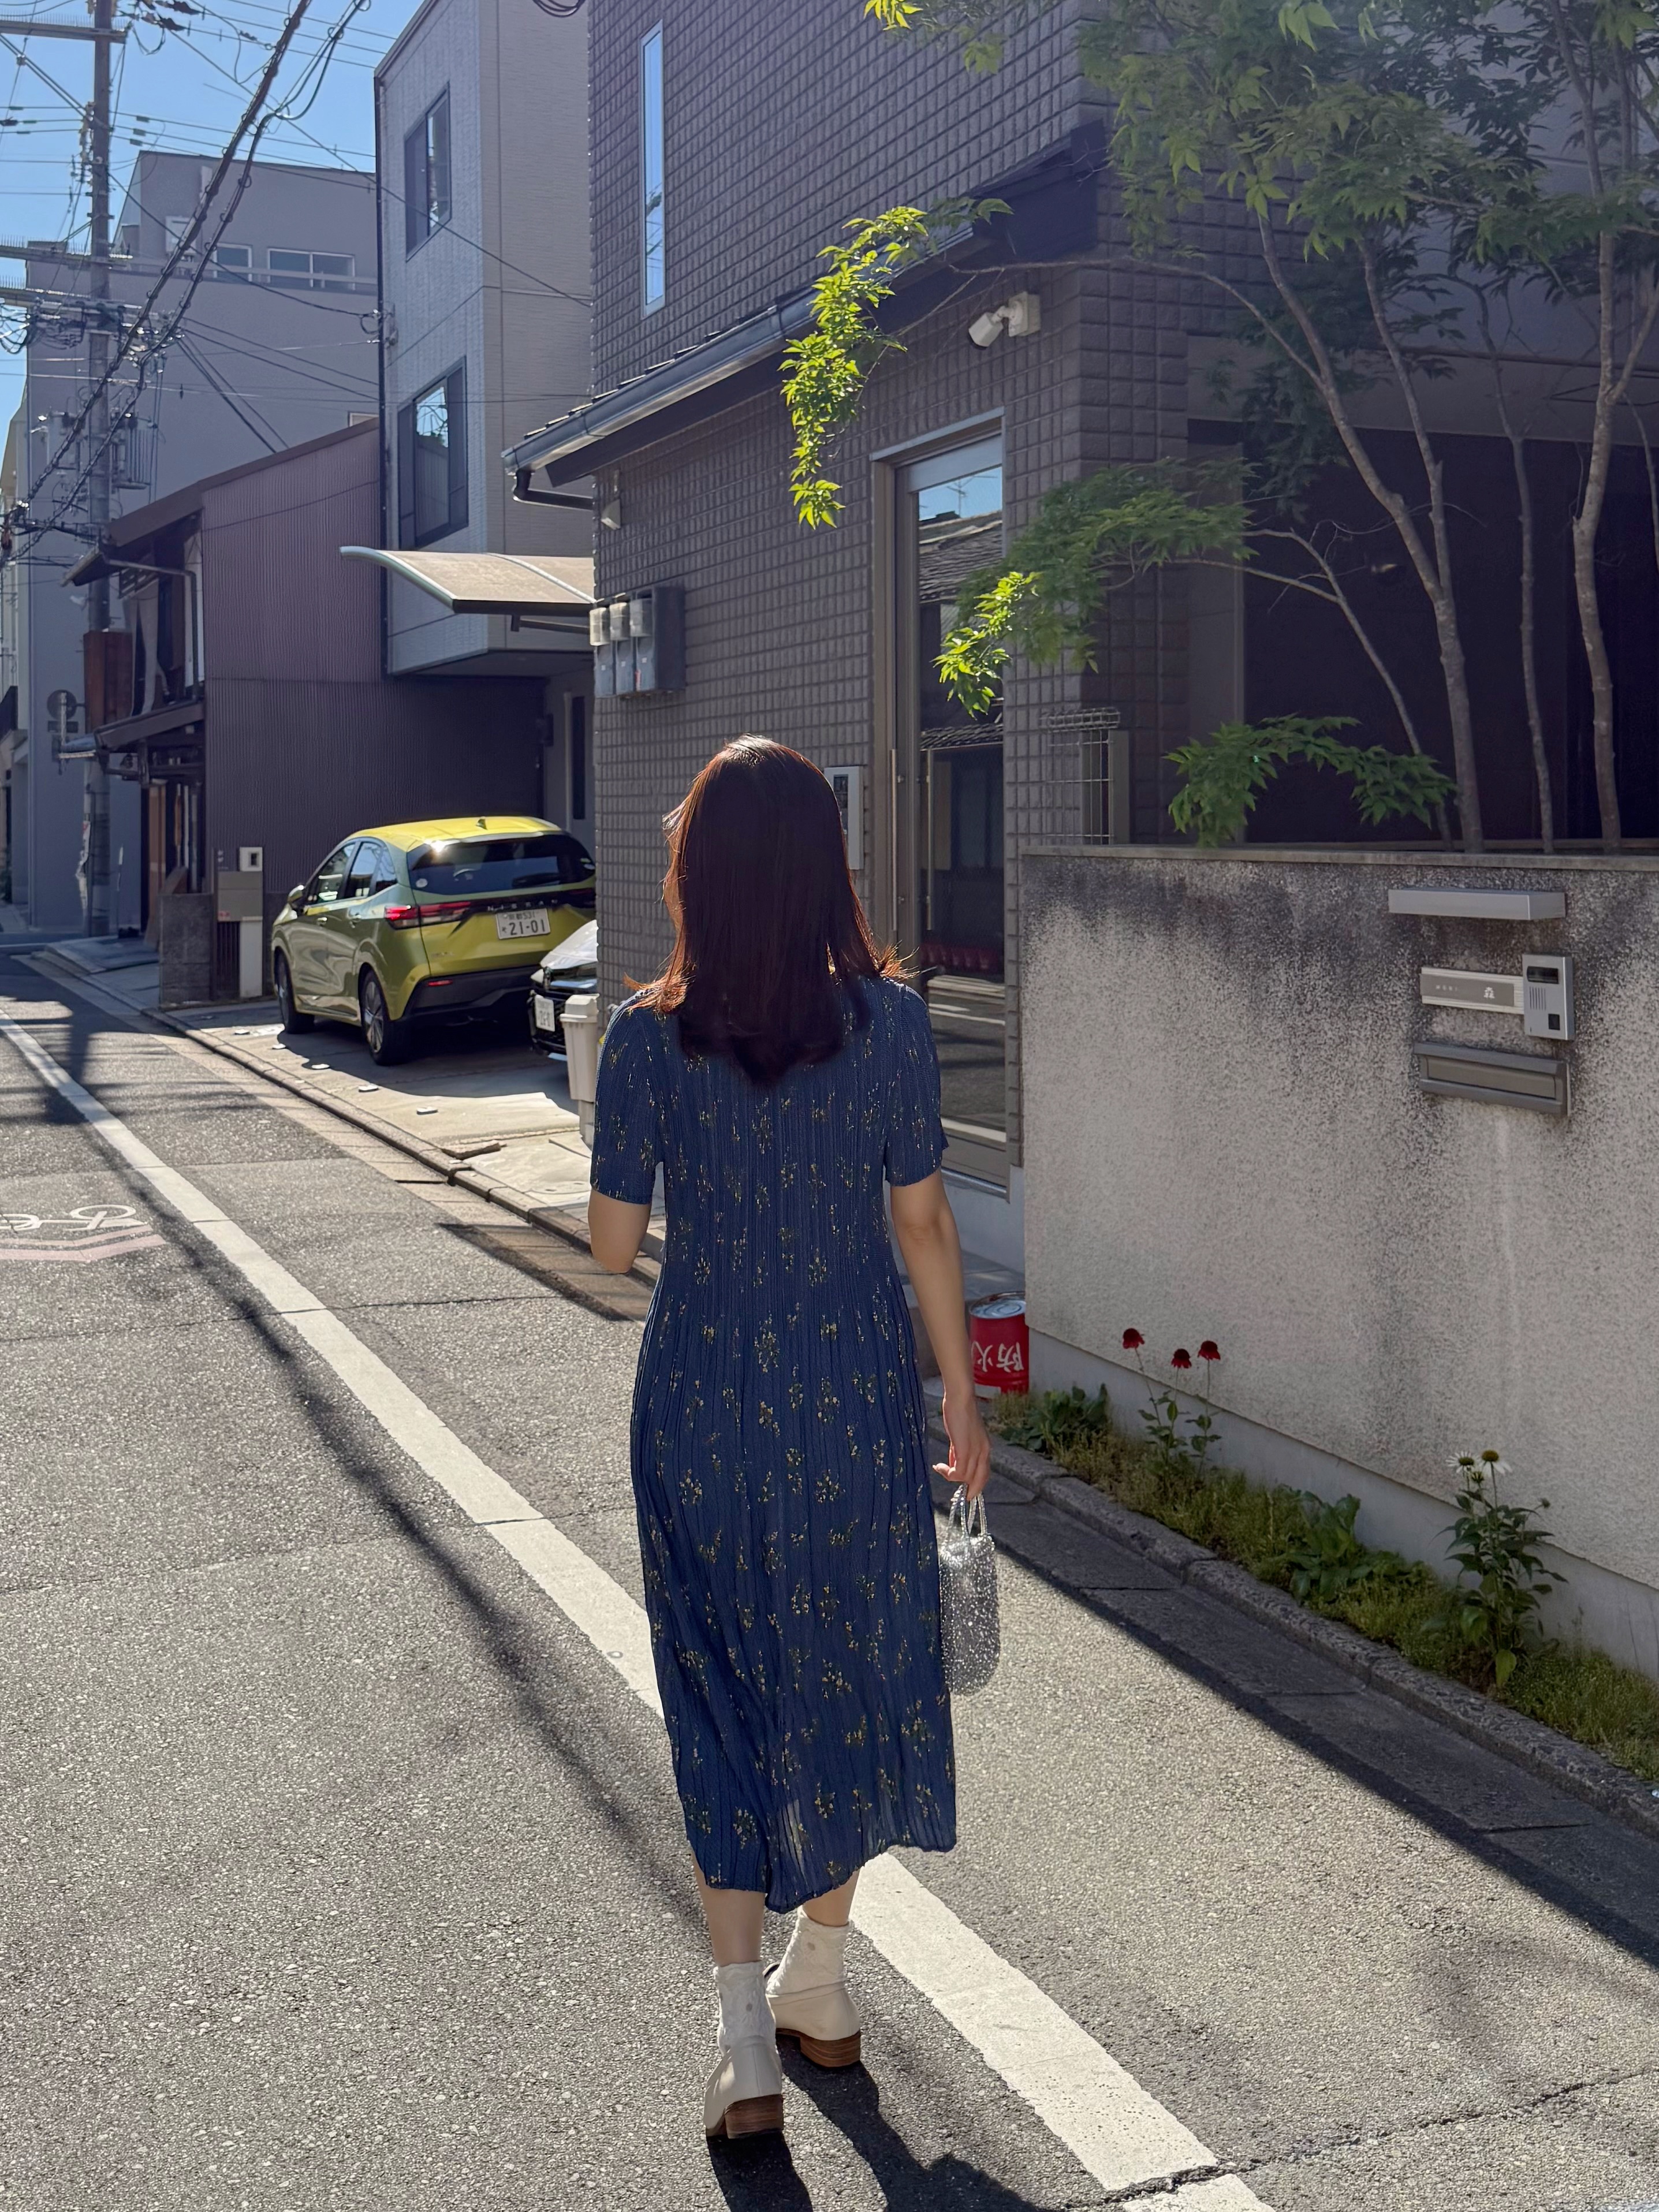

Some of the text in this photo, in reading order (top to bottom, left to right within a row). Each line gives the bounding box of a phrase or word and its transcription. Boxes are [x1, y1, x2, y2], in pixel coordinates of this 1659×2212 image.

[487, 899, 558, 911] NISSAN
[509, 919, 545, 935] 21-01
[971, 1341, 1024, 1372] 防火
